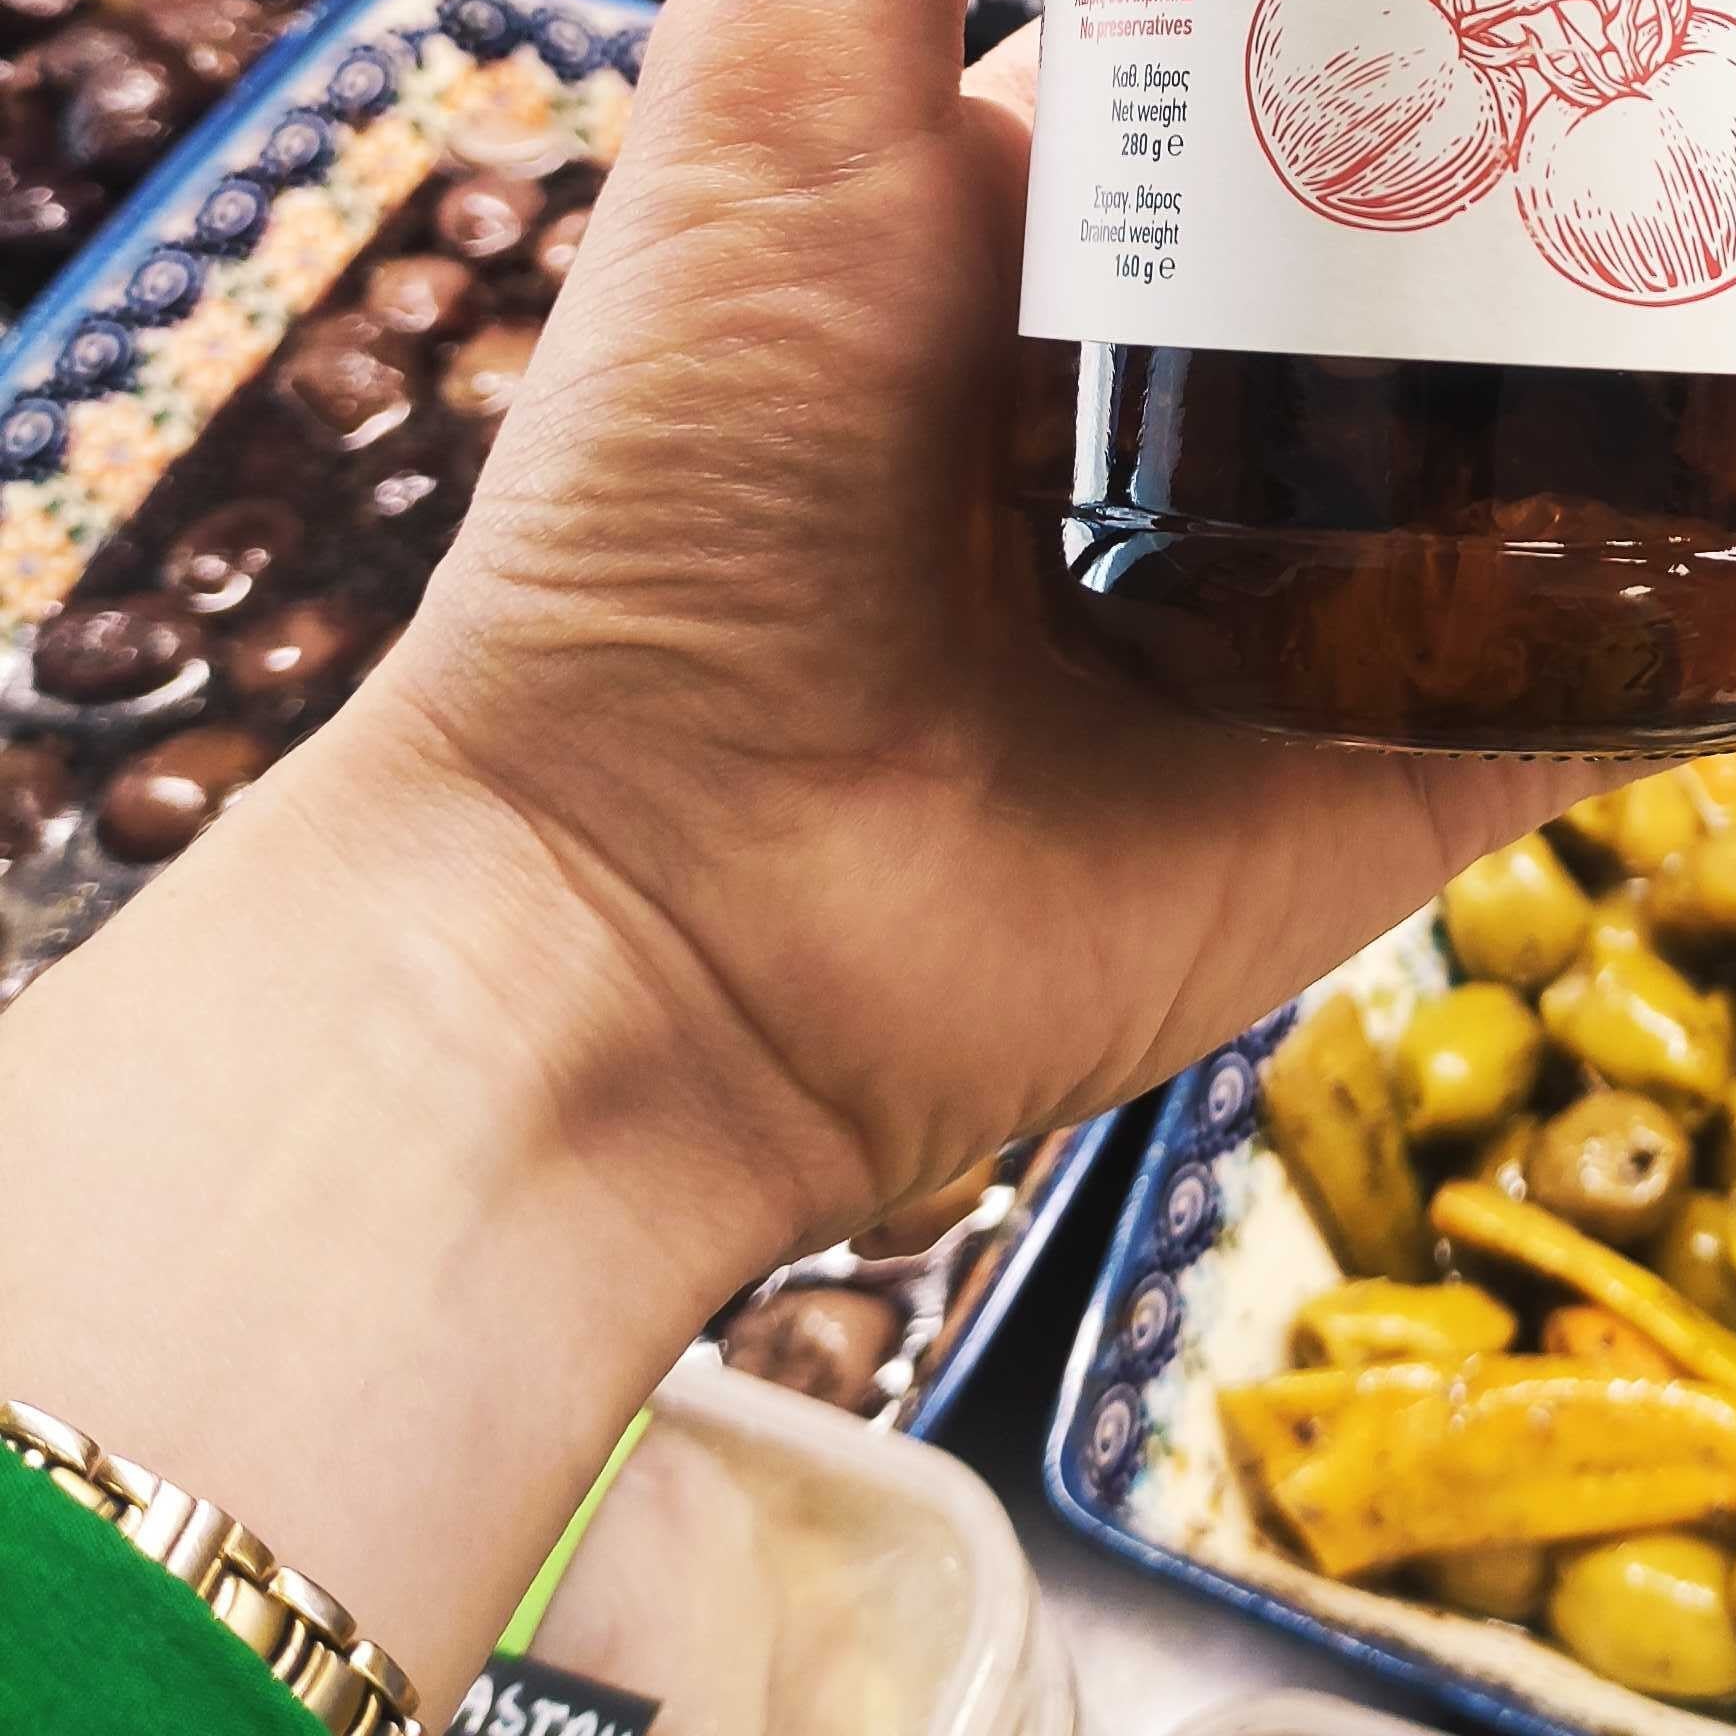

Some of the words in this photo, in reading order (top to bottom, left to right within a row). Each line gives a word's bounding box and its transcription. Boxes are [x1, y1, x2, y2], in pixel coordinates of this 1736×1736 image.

[1080, 15, 1095, 40] No
[1096, 12, 1193, 44] preservatives
[1112, 63, 1140, 88] Καθ.
[1143, 62, 1190, 94] βάρος
[1111, 97, 1134, 123] Net
[1137, 97, 1188, 128] weight
[1121, 132, 1148, 156] 280
[1152, 138, 1162, 162] g
[1135, 184, 1182, 214] βάρος
[1080, 217, 1126, 243] Drained
[1129, 219, 1179, 250] weight
[1115, 253, 1140, 278] 160
[1143, 260, 1153, 284] g
